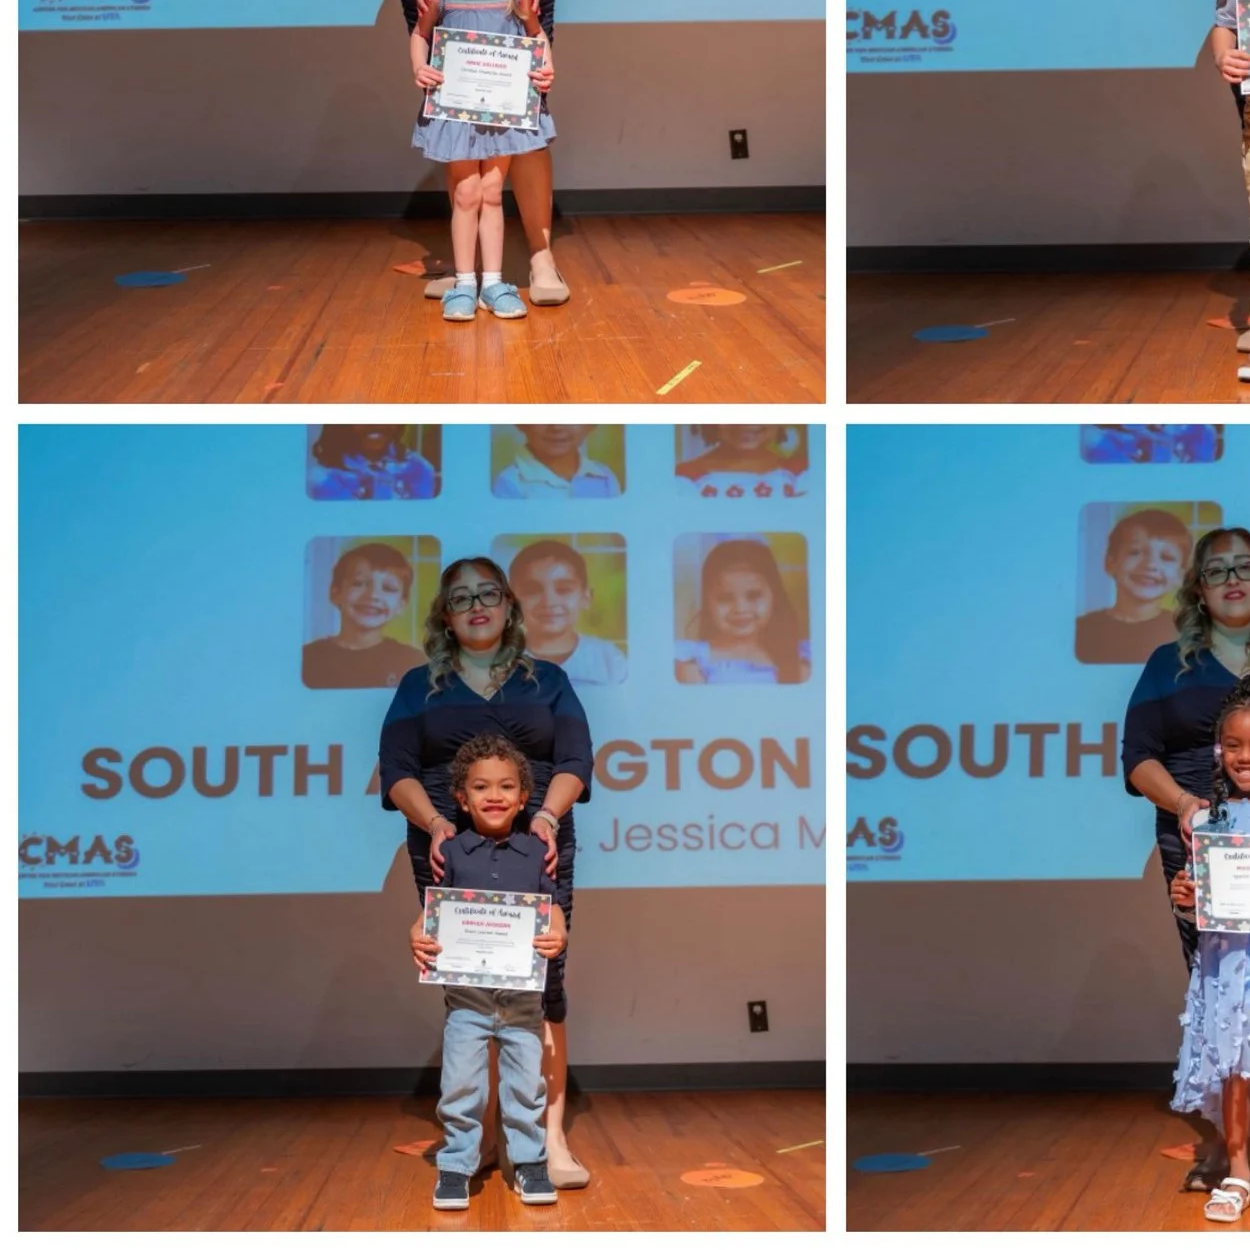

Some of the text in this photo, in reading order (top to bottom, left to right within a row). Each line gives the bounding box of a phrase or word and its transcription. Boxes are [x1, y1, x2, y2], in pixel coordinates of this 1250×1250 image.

[81, 744, 342, 800] SOUTH
[846, 722, 1117, 779] SOUTH
[18, 834, 140, 869] CMAS
[599, 815, 779, 852] Jessica
